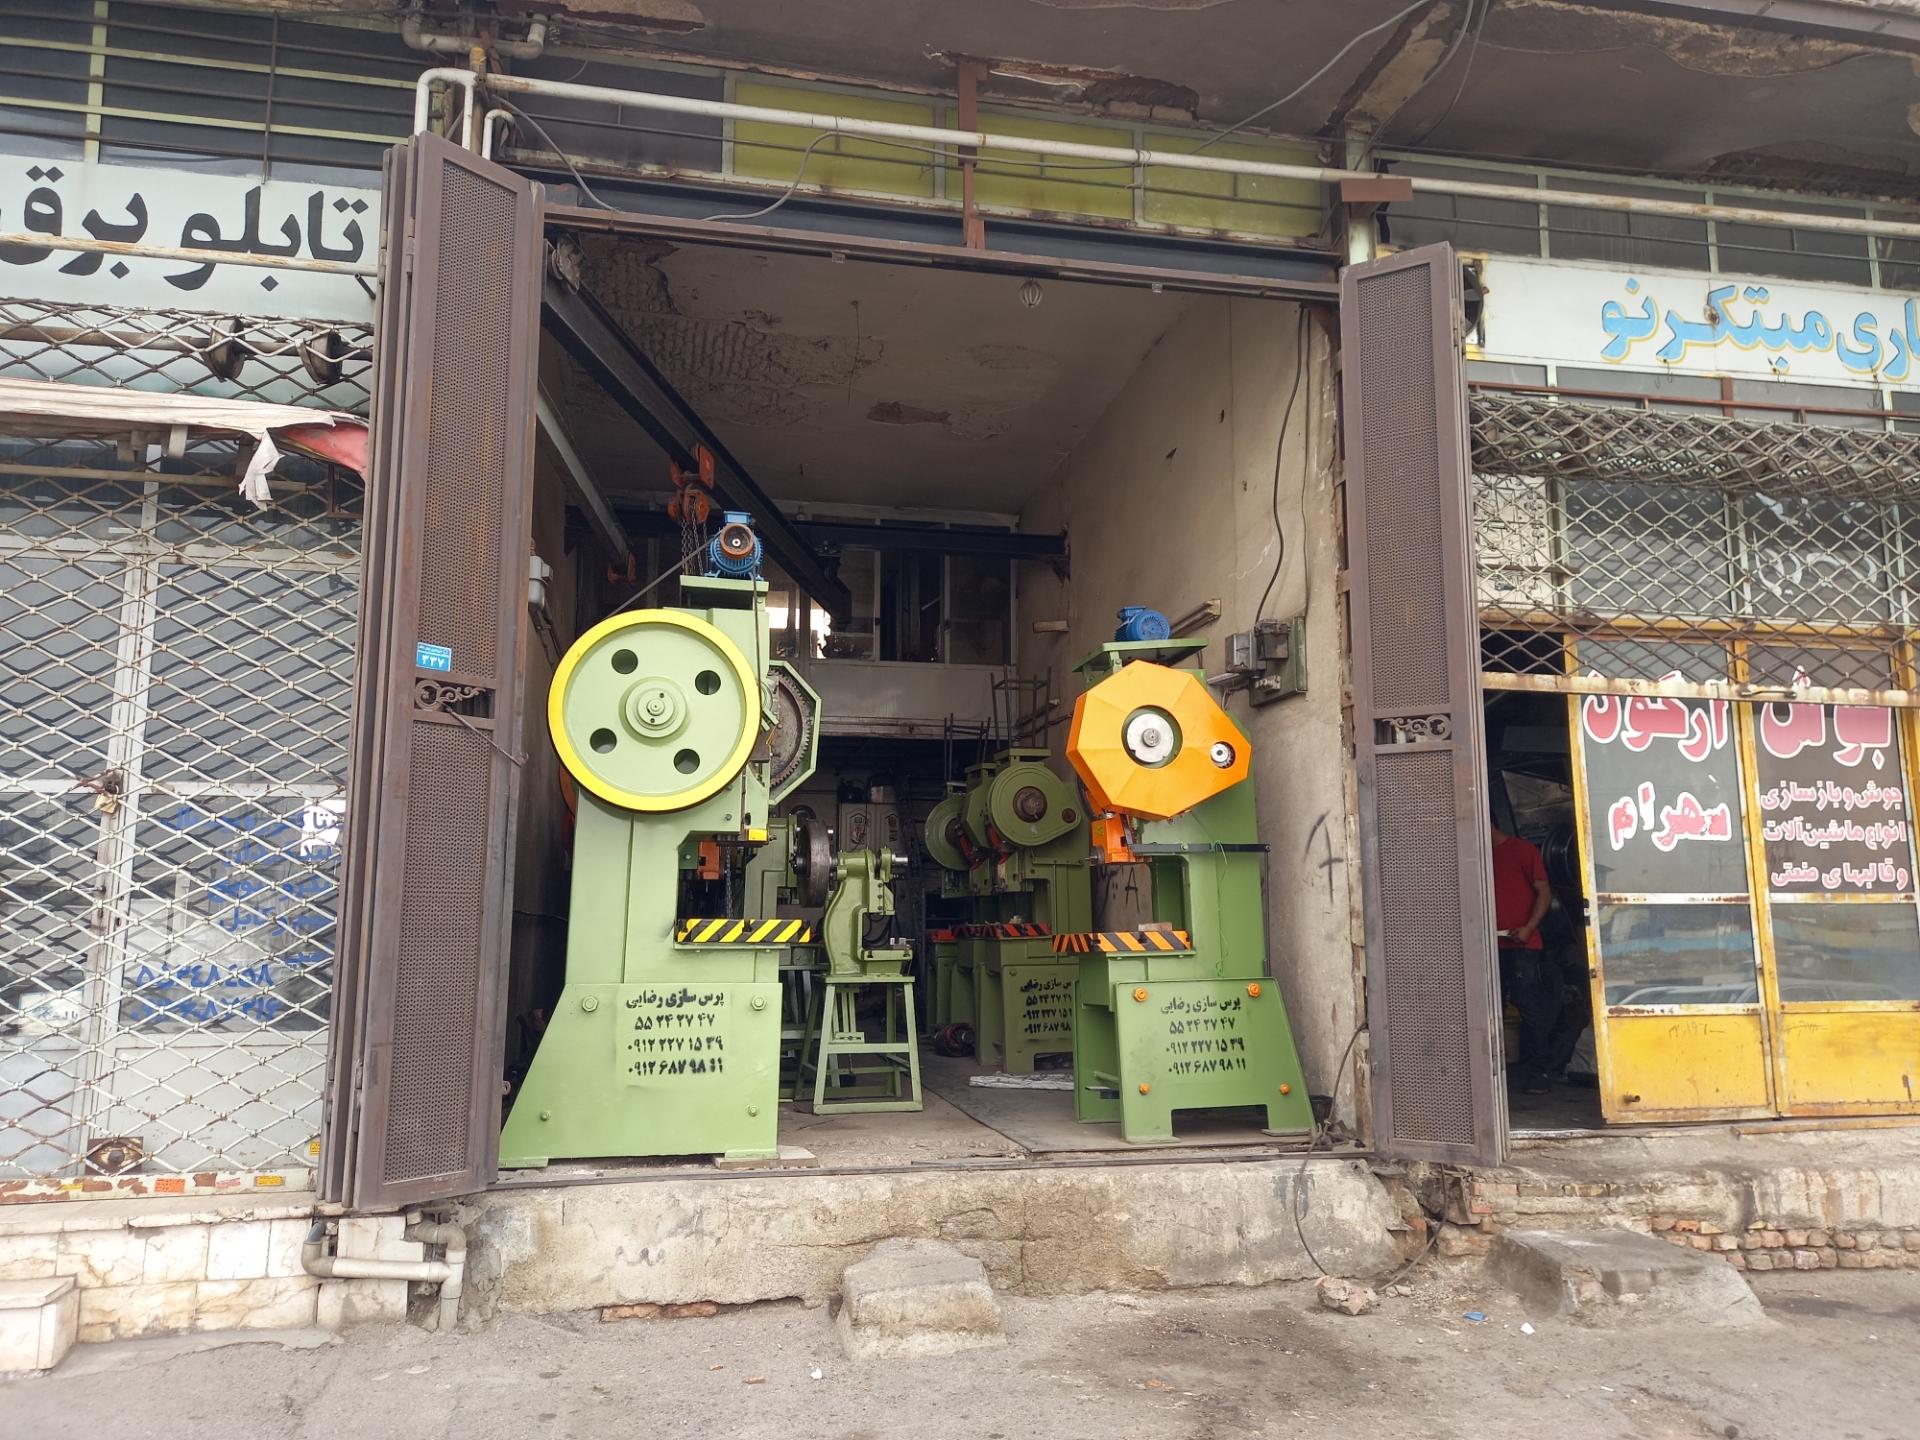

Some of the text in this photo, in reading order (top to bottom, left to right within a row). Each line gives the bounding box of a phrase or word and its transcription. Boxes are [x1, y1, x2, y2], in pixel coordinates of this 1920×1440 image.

[0, 165, 369, 291] تابلو برق
[1854, 780, 1903, 811] جوش
[1865, 820, 1907, 850] انواع
